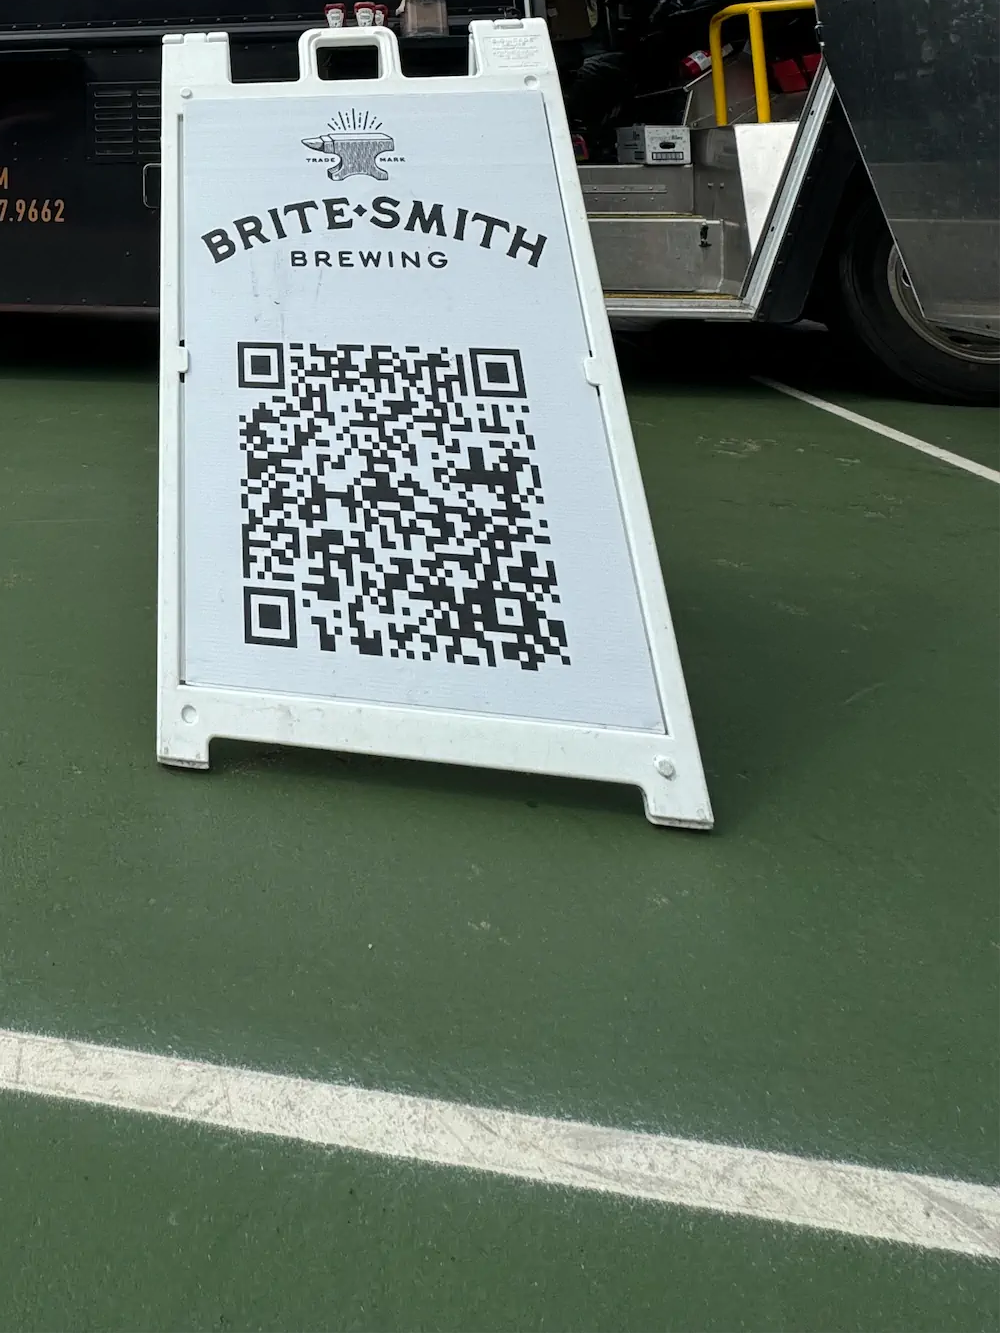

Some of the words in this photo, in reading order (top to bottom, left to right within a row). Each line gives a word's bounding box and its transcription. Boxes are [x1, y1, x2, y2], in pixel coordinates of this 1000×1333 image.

[201, 197, 353, 264] BRITE
[370, 196, 548, 268] SMITH
[290, 250, 448, 269] BREWING
